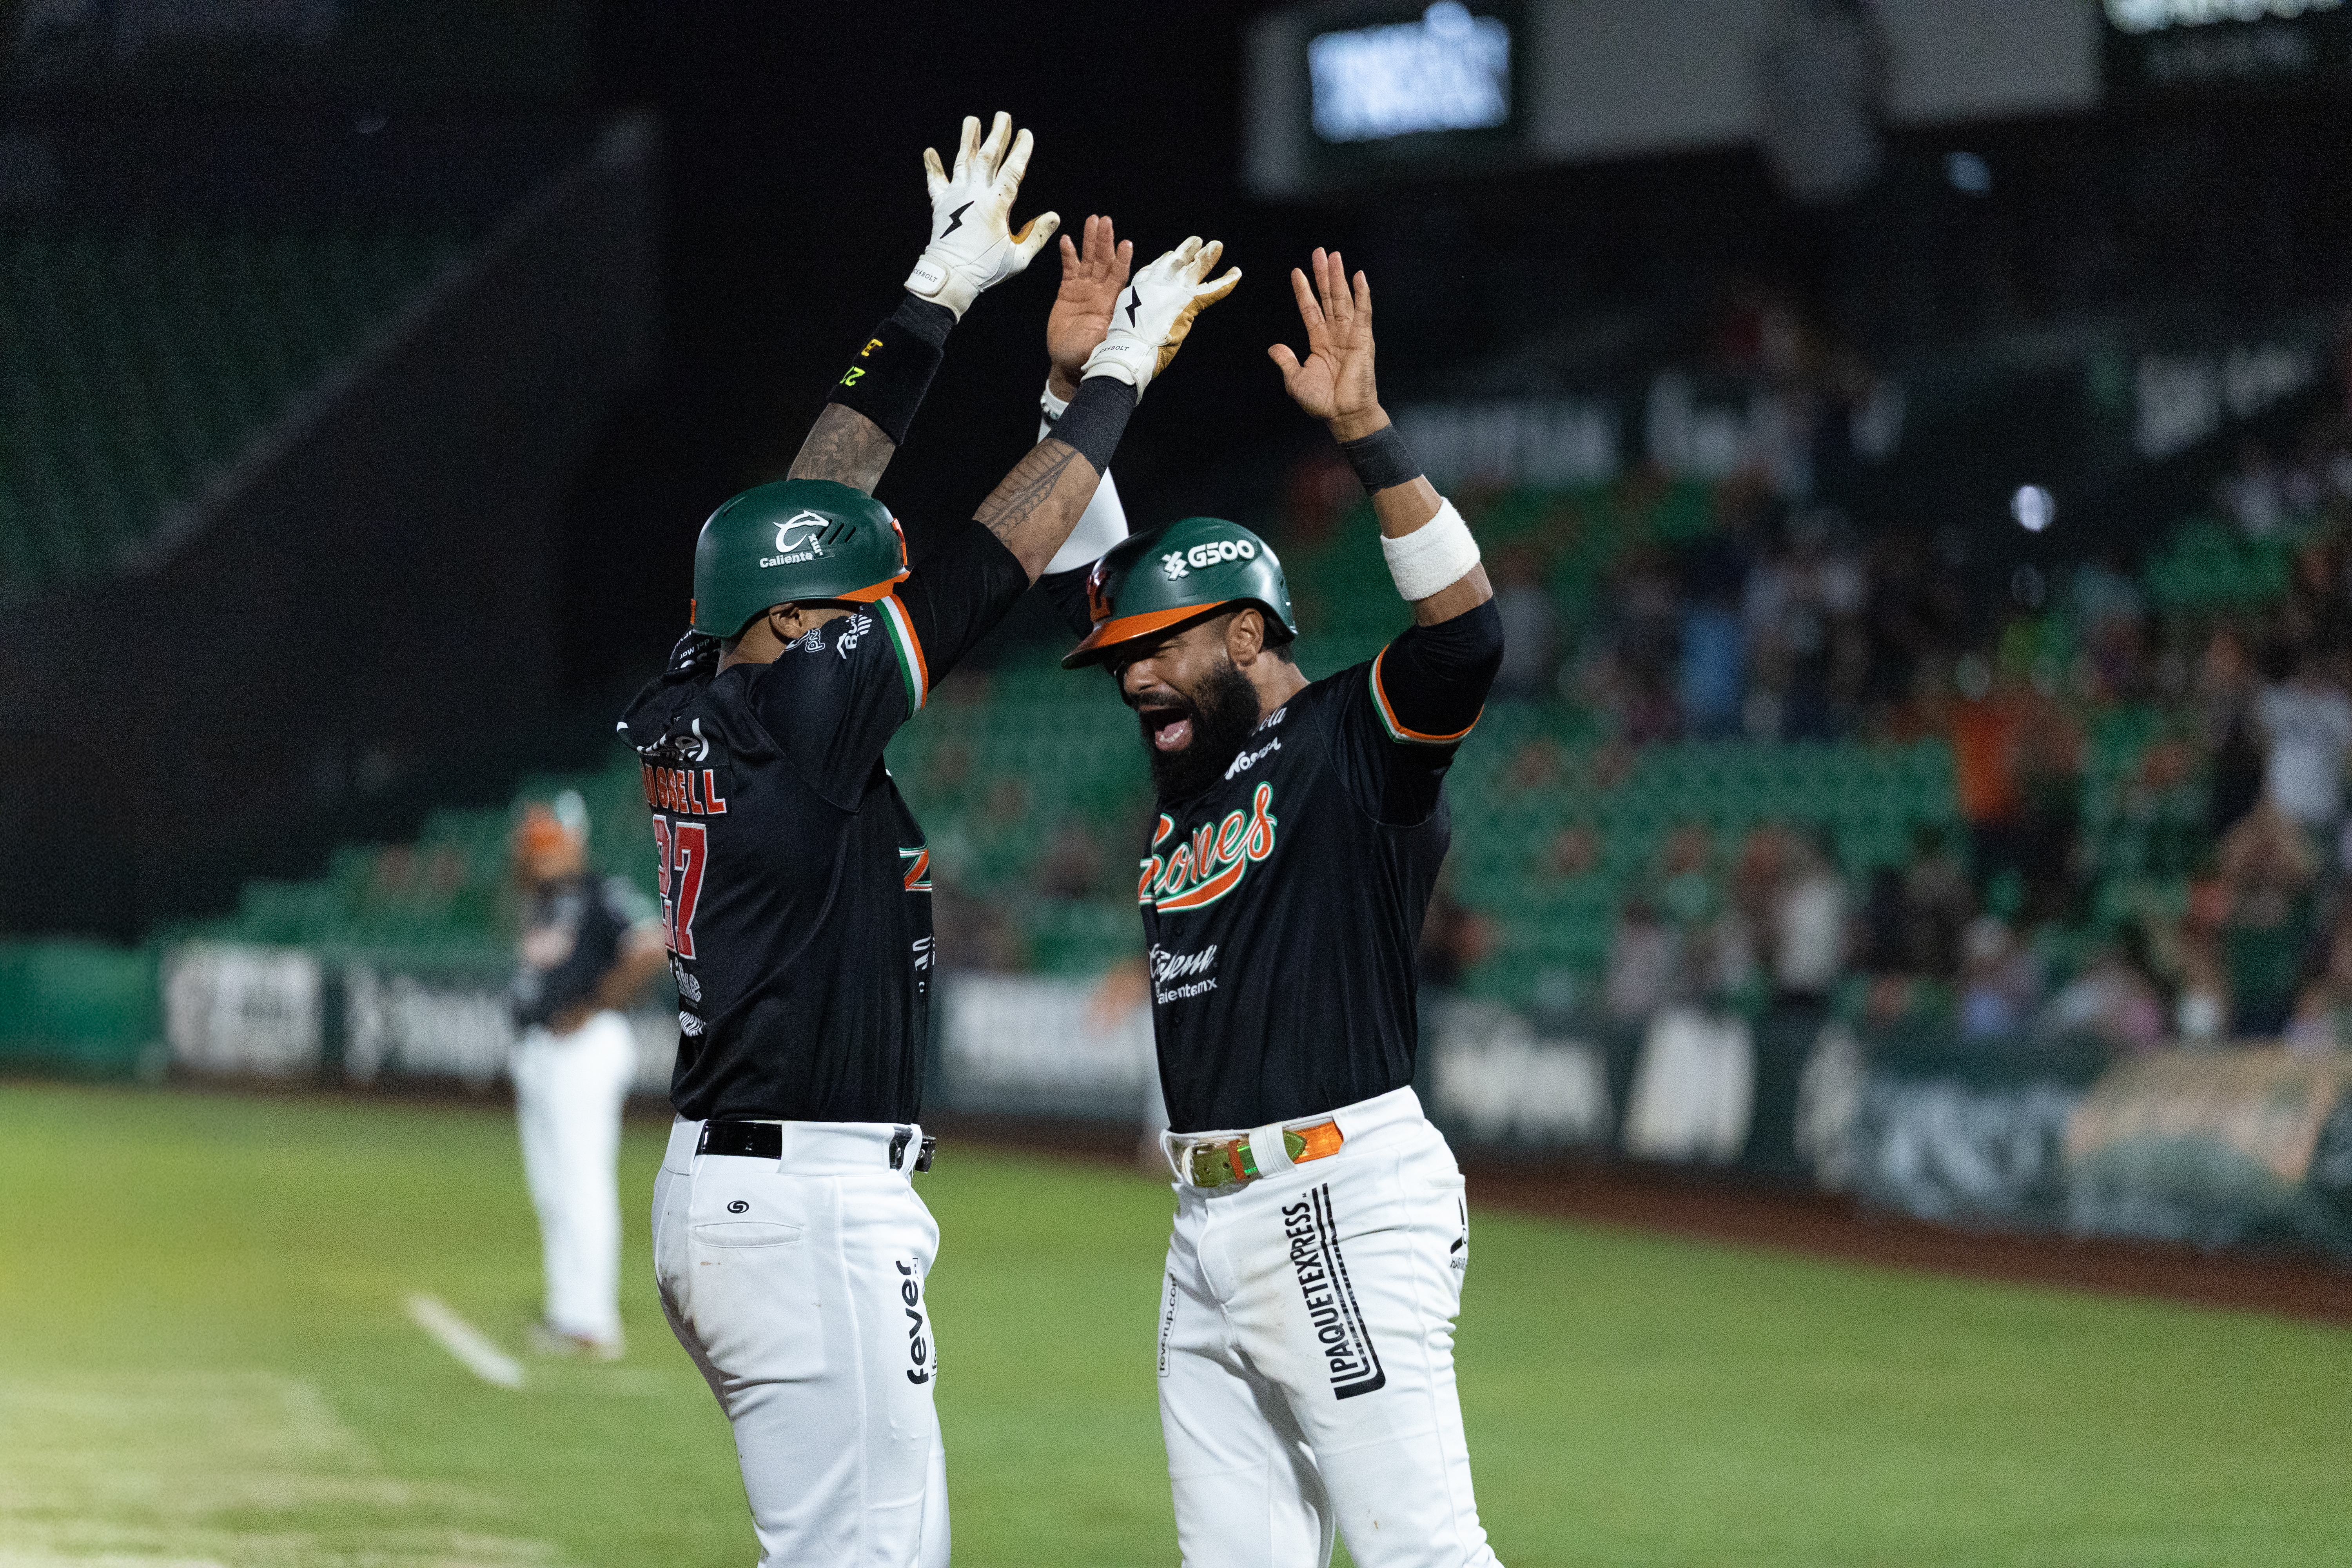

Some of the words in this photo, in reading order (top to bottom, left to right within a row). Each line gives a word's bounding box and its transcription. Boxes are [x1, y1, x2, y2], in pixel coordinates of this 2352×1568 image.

[921, 272, 938, 282] BOLT
[759, 551, 814, 568] Caliente
[1188, 539, 1255, 568] G500
[640, 758, 727, 815] USSELL
[1281, 1202, 1359, 1373] PAQUETEXPRESS
[896, 1260, 929, 1385] fever
